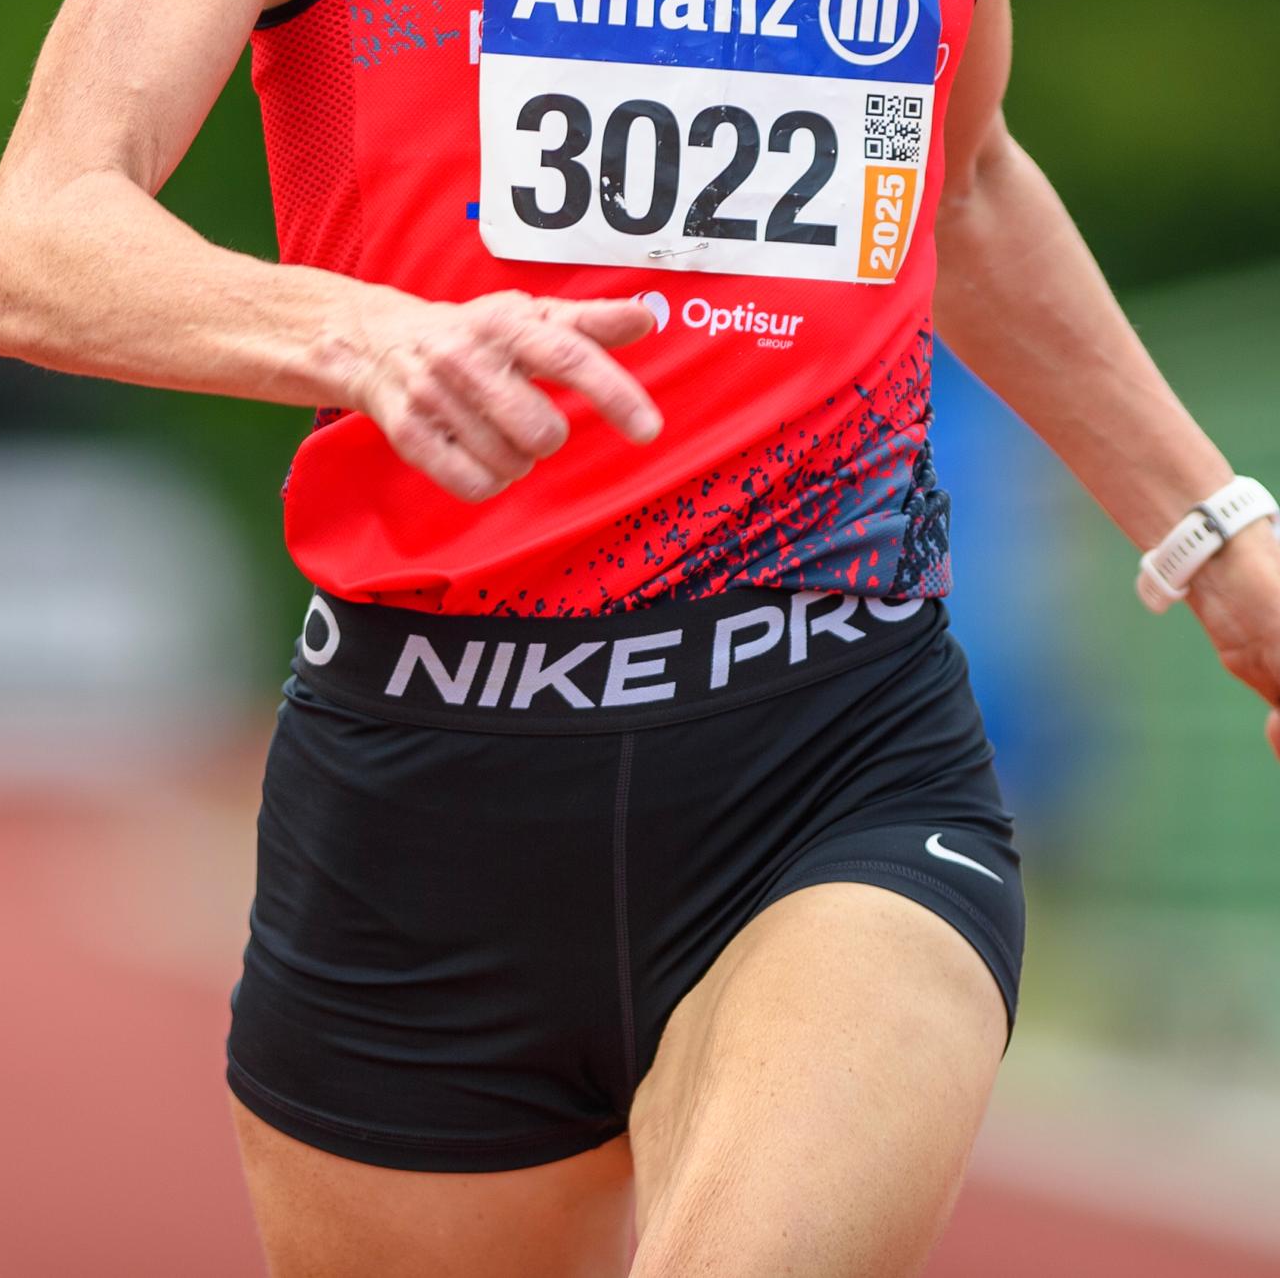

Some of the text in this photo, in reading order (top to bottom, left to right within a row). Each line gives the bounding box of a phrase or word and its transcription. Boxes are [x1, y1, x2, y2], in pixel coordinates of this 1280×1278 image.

[510, 93, 839, 246] 3022
[869, 174, 906, 271] 2025
[681, 297, 804, 337] Optisur
[756, 337, 794, 350] GROUP
[384, 629, 683, 710] NIKE
